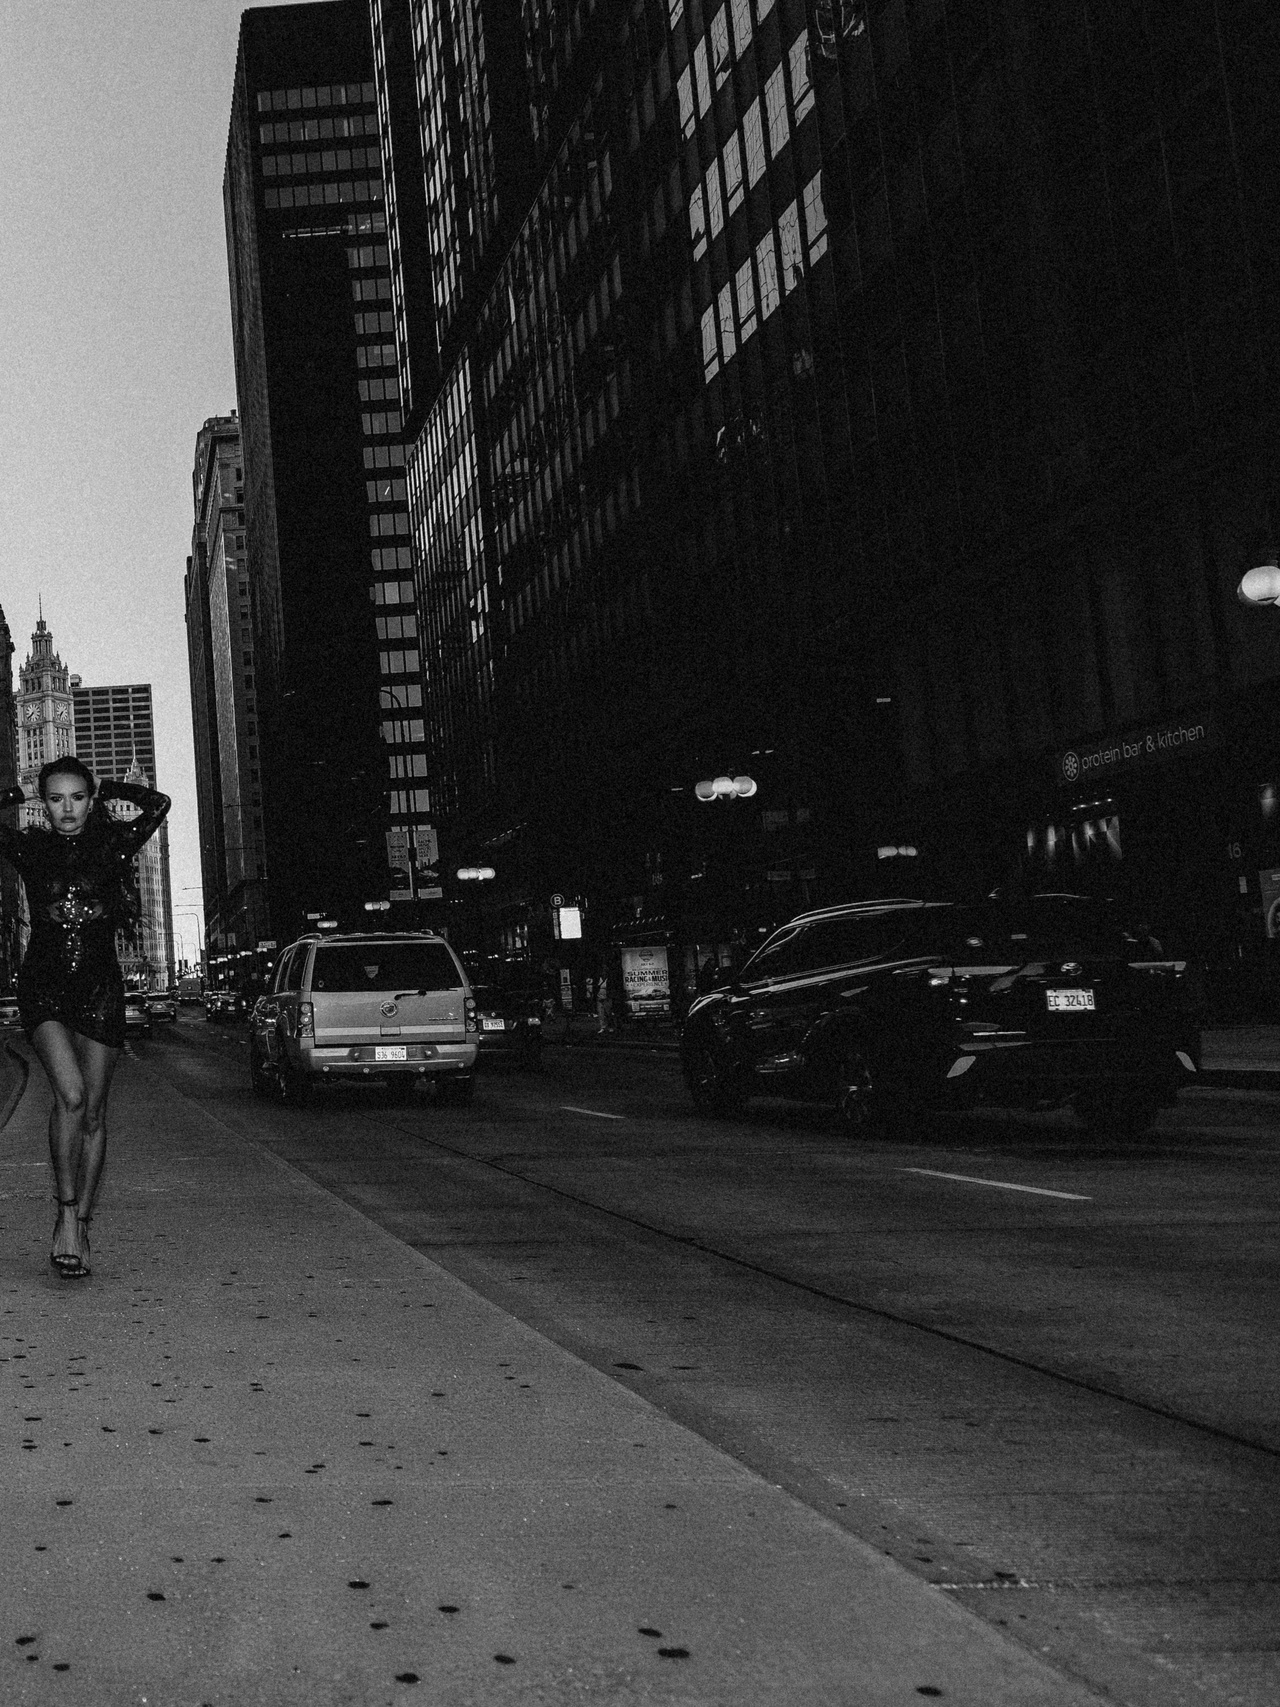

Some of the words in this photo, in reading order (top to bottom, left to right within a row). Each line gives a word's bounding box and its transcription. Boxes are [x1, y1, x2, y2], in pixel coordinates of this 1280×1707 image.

[1082, 746, 1120, 771] protein
[1122, 741, 1142, 758] bar
[1146, 735, 1155, 752] &
[1157, 725, 1204, 749] kitchen
[1048, 995, 1060, 1007] EC
